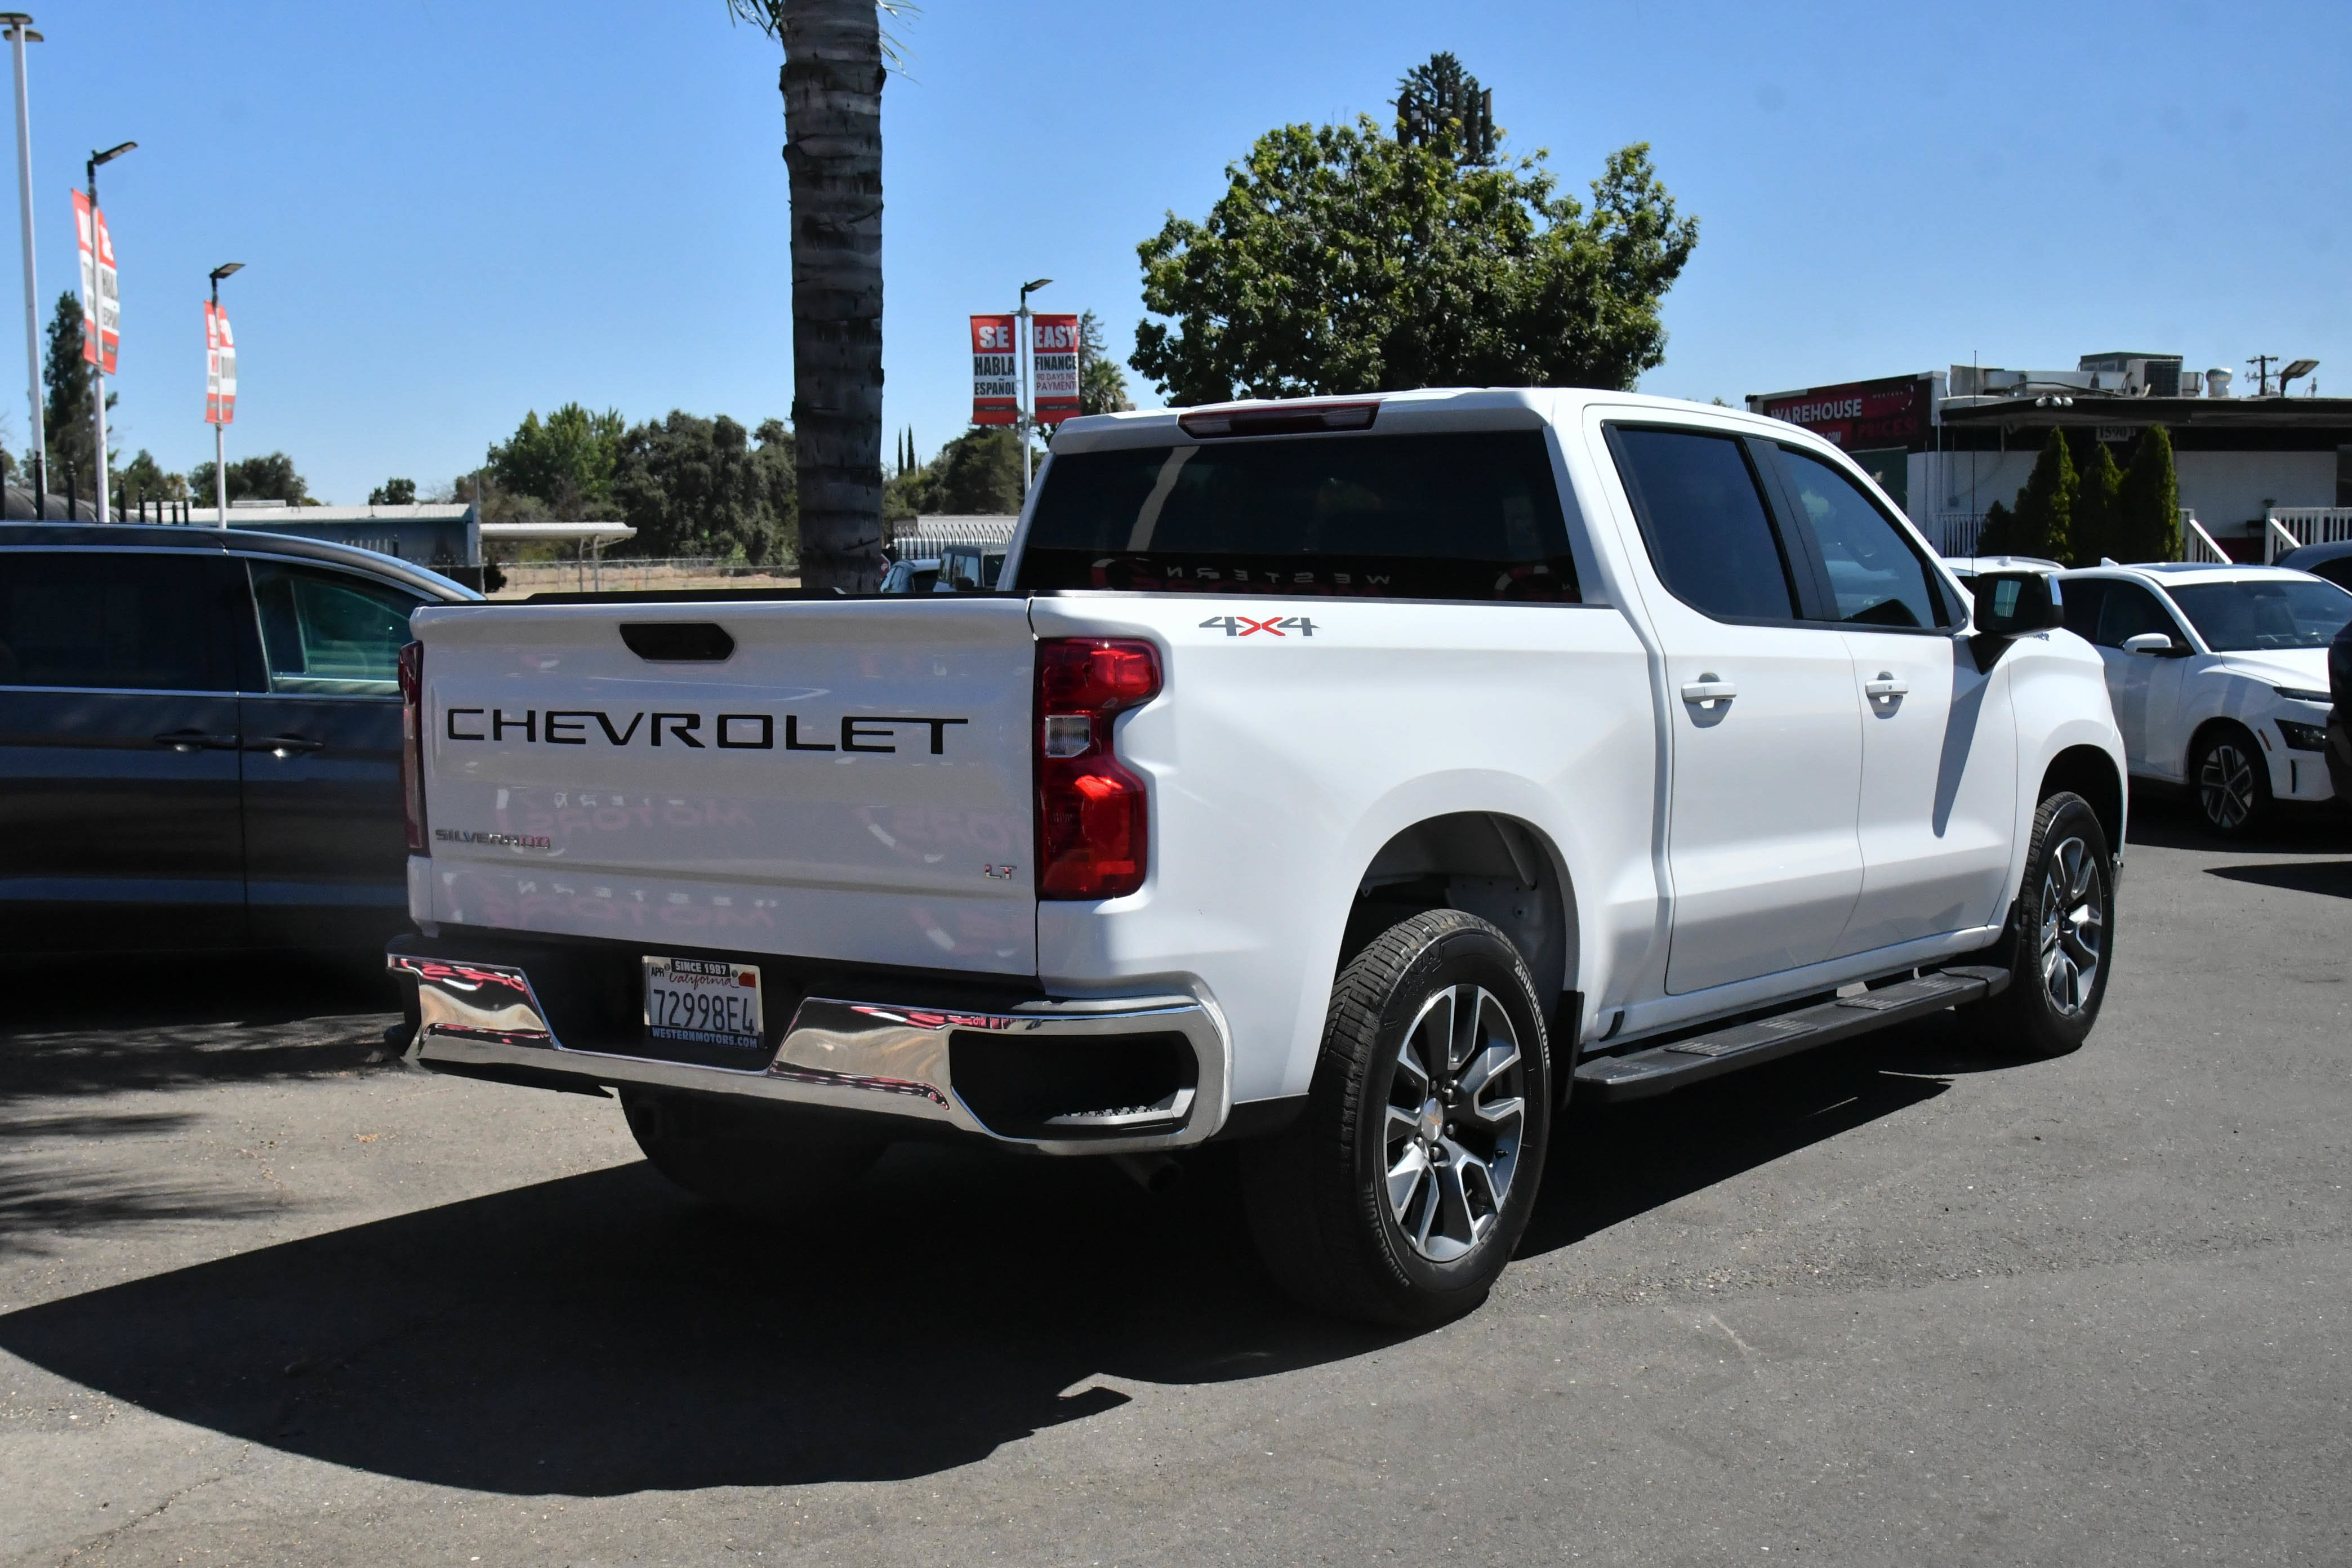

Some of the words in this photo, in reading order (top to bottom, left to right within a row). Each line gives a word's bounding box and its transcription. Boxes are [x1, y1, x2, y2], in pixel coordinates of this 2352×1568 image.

[979, 326, 1009, 349] SE
[1034, 325, 1076, 348] EASY
[974, 356, 1015, 376] HABLA
[1035, 355, 1077, 371] FINANCE
[974, 378, 1016, 395] ESPAÑOL
[1770, 399, 1862, 424] WAREHOUSE
[447, 708, 969, 755] CHEVROLET
[435, 828, 550, 849] SILVERADO
[984, 864, 1018, 880] LT
[651, 966, 665, 978] APR
[675, 960, 702, 973] SINCE
[704, 963, 727, 975] 1987
[669, 972, 740, 990] California
[653, 988, 755, 1035] 72998E4
[1513, 958, 1551, 1069] BRIDGESTONE
[652, 1026, 758, 1049] WESTERNMOTORS.COM
